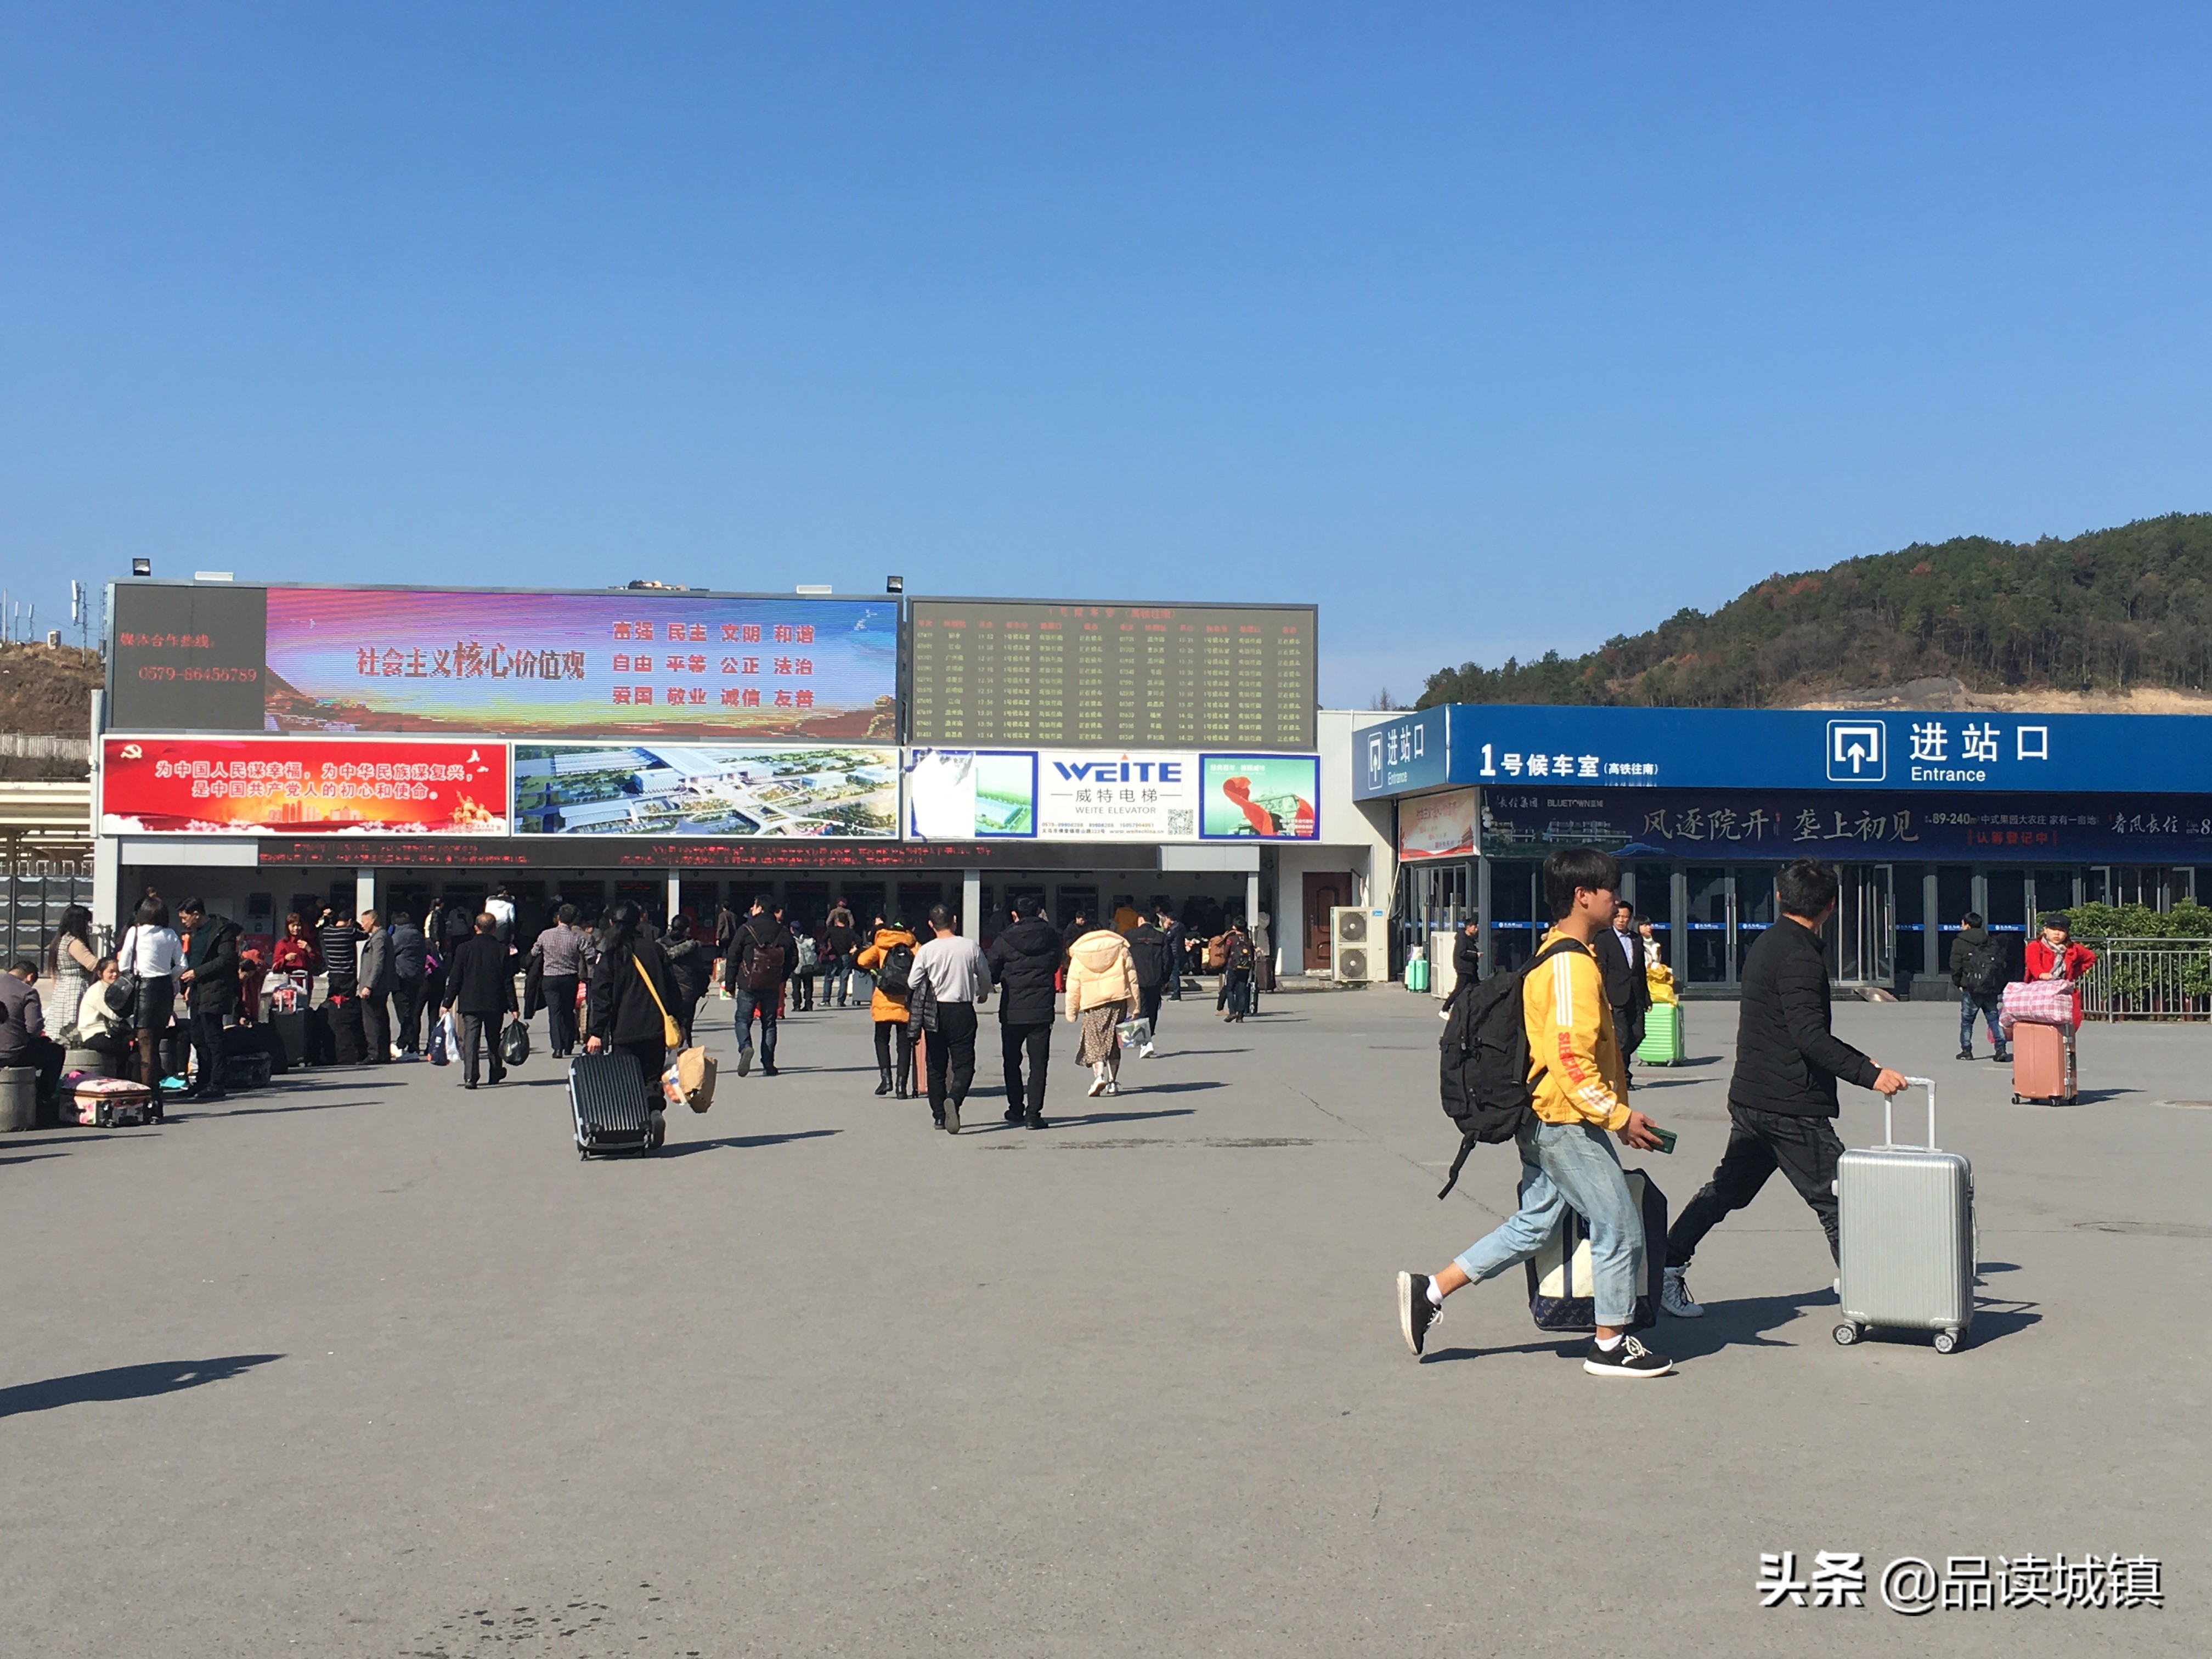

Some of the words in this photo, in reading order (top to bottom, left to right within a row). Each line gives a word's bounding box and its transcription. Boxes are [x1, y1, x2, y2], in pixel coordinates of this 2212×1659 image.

[613, 621, 654, 641] 富强
[668, 623, 708, 642] 民主
[721, 623, 761, 643] 文明
[774, 624, 814, 644] 和谐
[356, 641, 585, 680] 社会主义核心价值观
[613, 654, 653, 673] 自由
[667, 654, 707, 674] 平等
[721, 656, 760, 675] 公正
[774, 657, 814, 675] 法治
[613, 686, 653, 705] 爱国
[667, 687, 707, 706] 敬业
[721, 688, 761, 707] 诚信
[774, 689, 814, 708] 友善
[1387, 724, 1424, 765] 进站口
[1910, 723, 2049, 761] 进站口
[155, 760, 474, 782] 为中国人民谋幸福，为中华民族谋复兴，
[1480, 743, 1600, 777] 1号候车室
[1052, 761, 1181, 782] WEITE
[1388, 771, 1407, 785] Entrance
[1911, 766, 1986, 782] Entrance
[192, 780, 438, 800] 是中国共产党人的初心和使命。
[1076, 788, 1158, 803] 威特电梯
[1641, 808, 1769, 841] 风逐院开
[1792, 809, 1919, 842] 垄上初见
